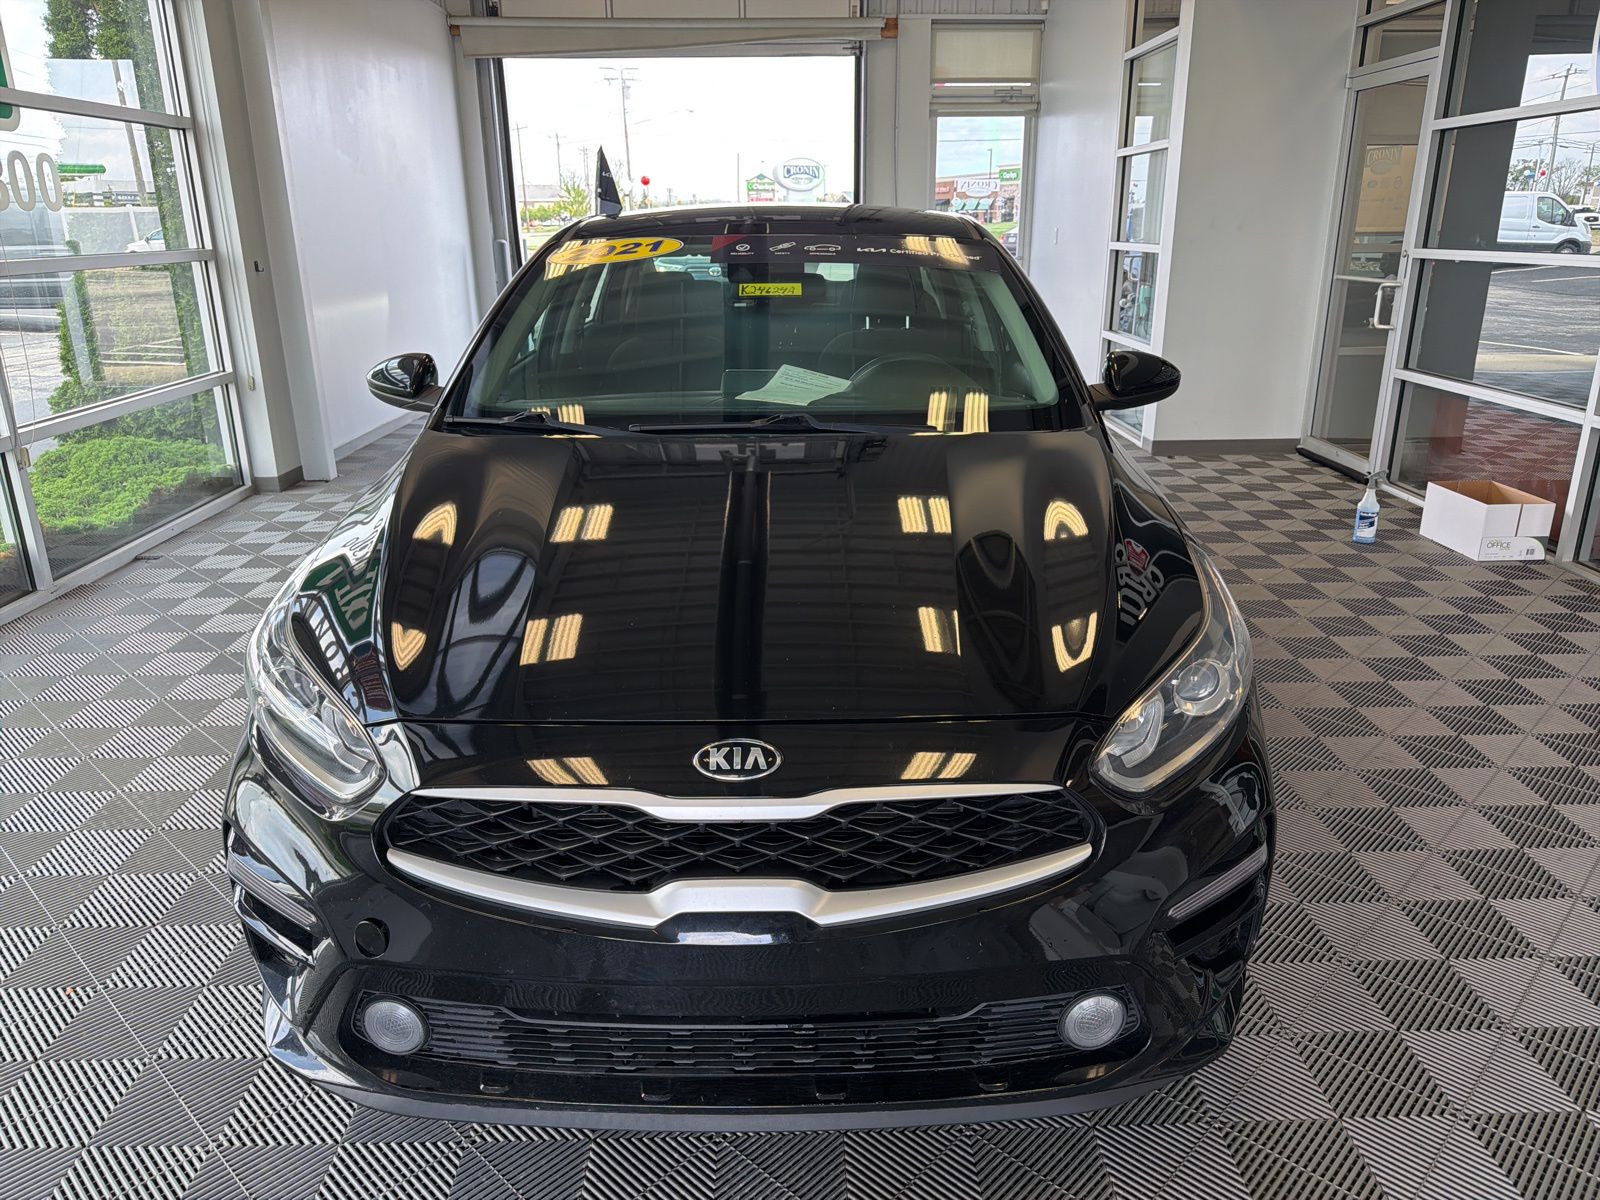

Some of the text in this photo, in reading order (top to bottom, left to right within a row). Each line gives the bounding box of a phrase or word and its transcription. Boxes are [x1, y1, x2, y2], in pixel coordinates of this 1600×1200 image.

[783, 165, 820, 179] CRONIN
[568, 239, 665, 261] 2021
[708, 746, 768, 770] KIA
